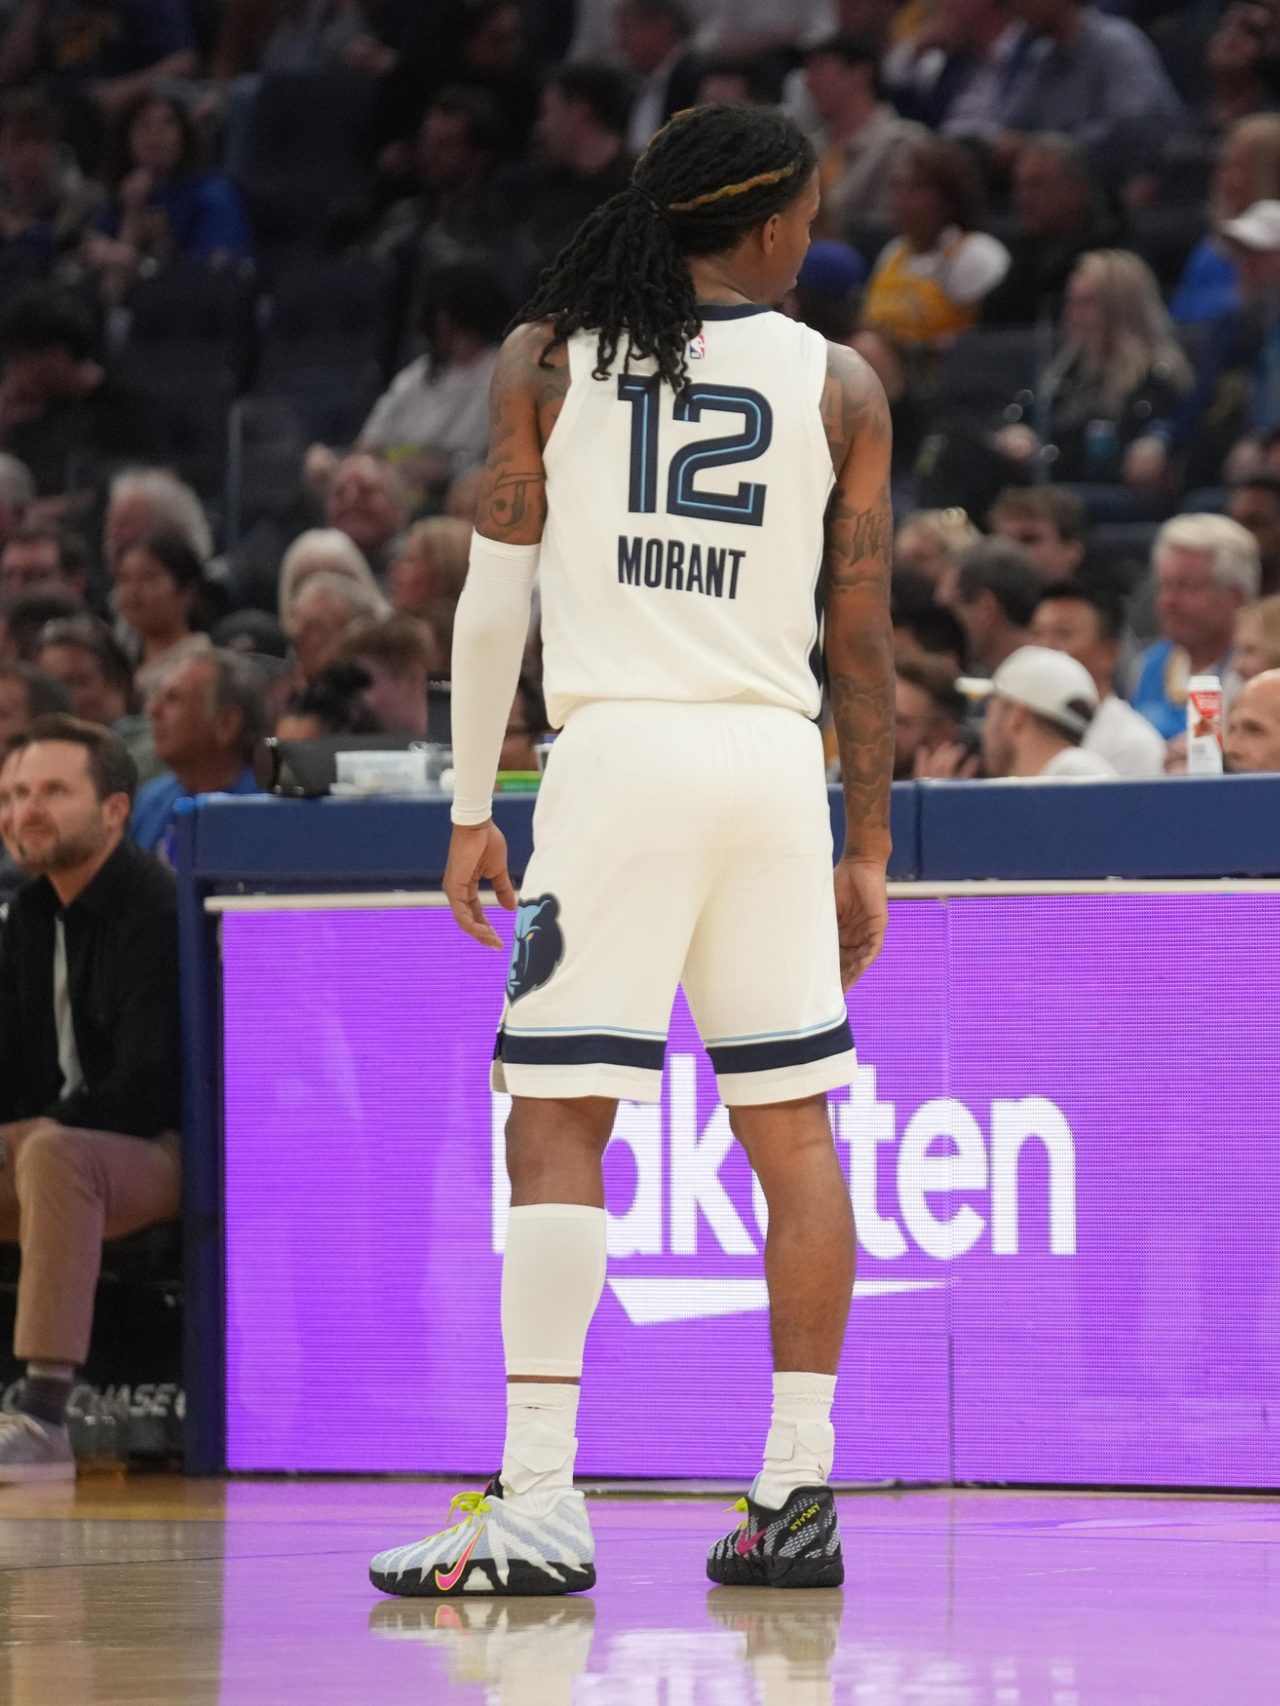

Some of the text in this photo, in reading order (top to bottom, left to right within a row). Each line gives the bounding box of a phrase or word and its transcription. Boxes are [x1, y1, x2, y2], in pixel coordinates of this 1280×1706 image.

[617, 373, 773, 526] 12
[617, 535, 746, 600] MORANT
[491, 1053, 1078, 1260] akten
